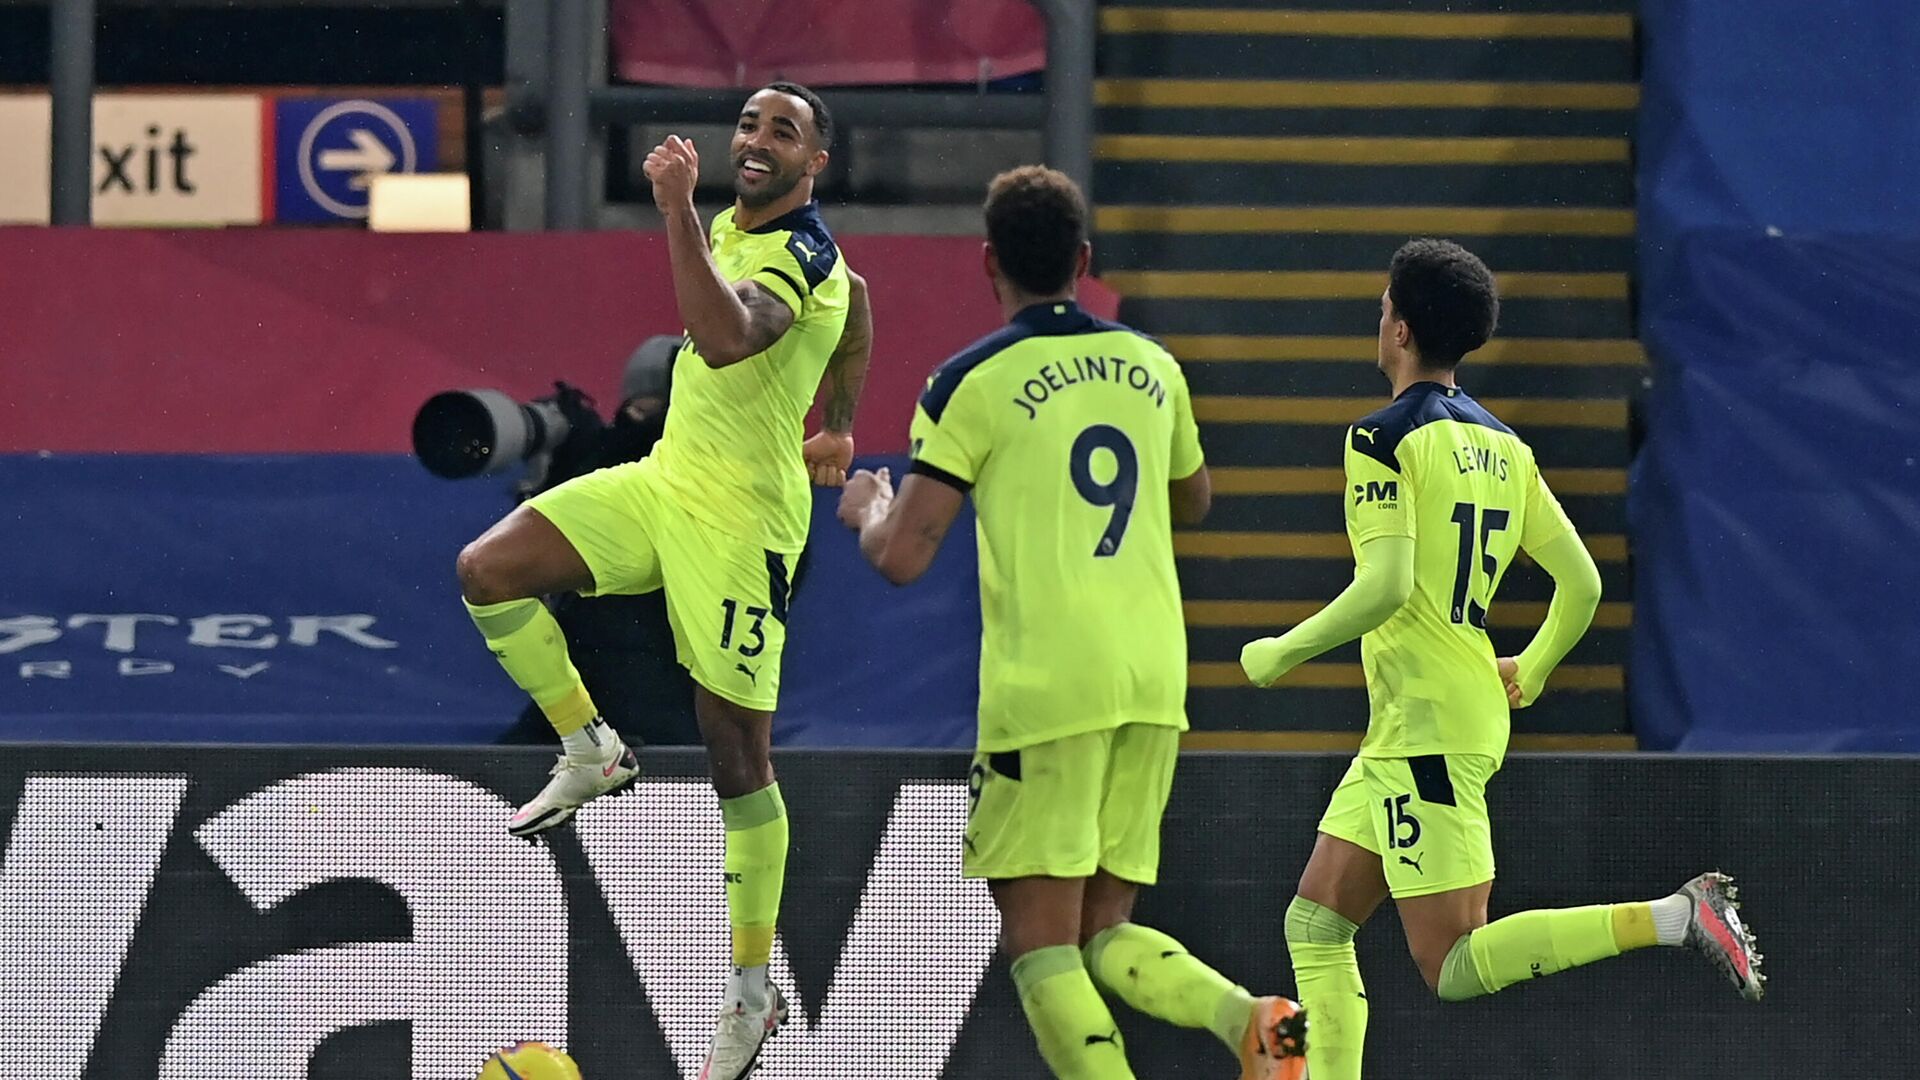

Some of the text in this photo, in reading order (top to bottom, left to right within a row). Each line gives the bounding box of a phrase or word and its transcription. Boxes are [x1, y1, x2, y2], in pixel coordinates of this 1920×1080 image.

[1013, 356, 1166, 420] JOELINTON
[1069, 424, 1139, 558] 9
[1453, 446, 1508, 482] LEWIS
[1450, 502, 1510, 629] 15
[720, 598, 768, 657] 13
[1383, 793, 1421, 849] 15
